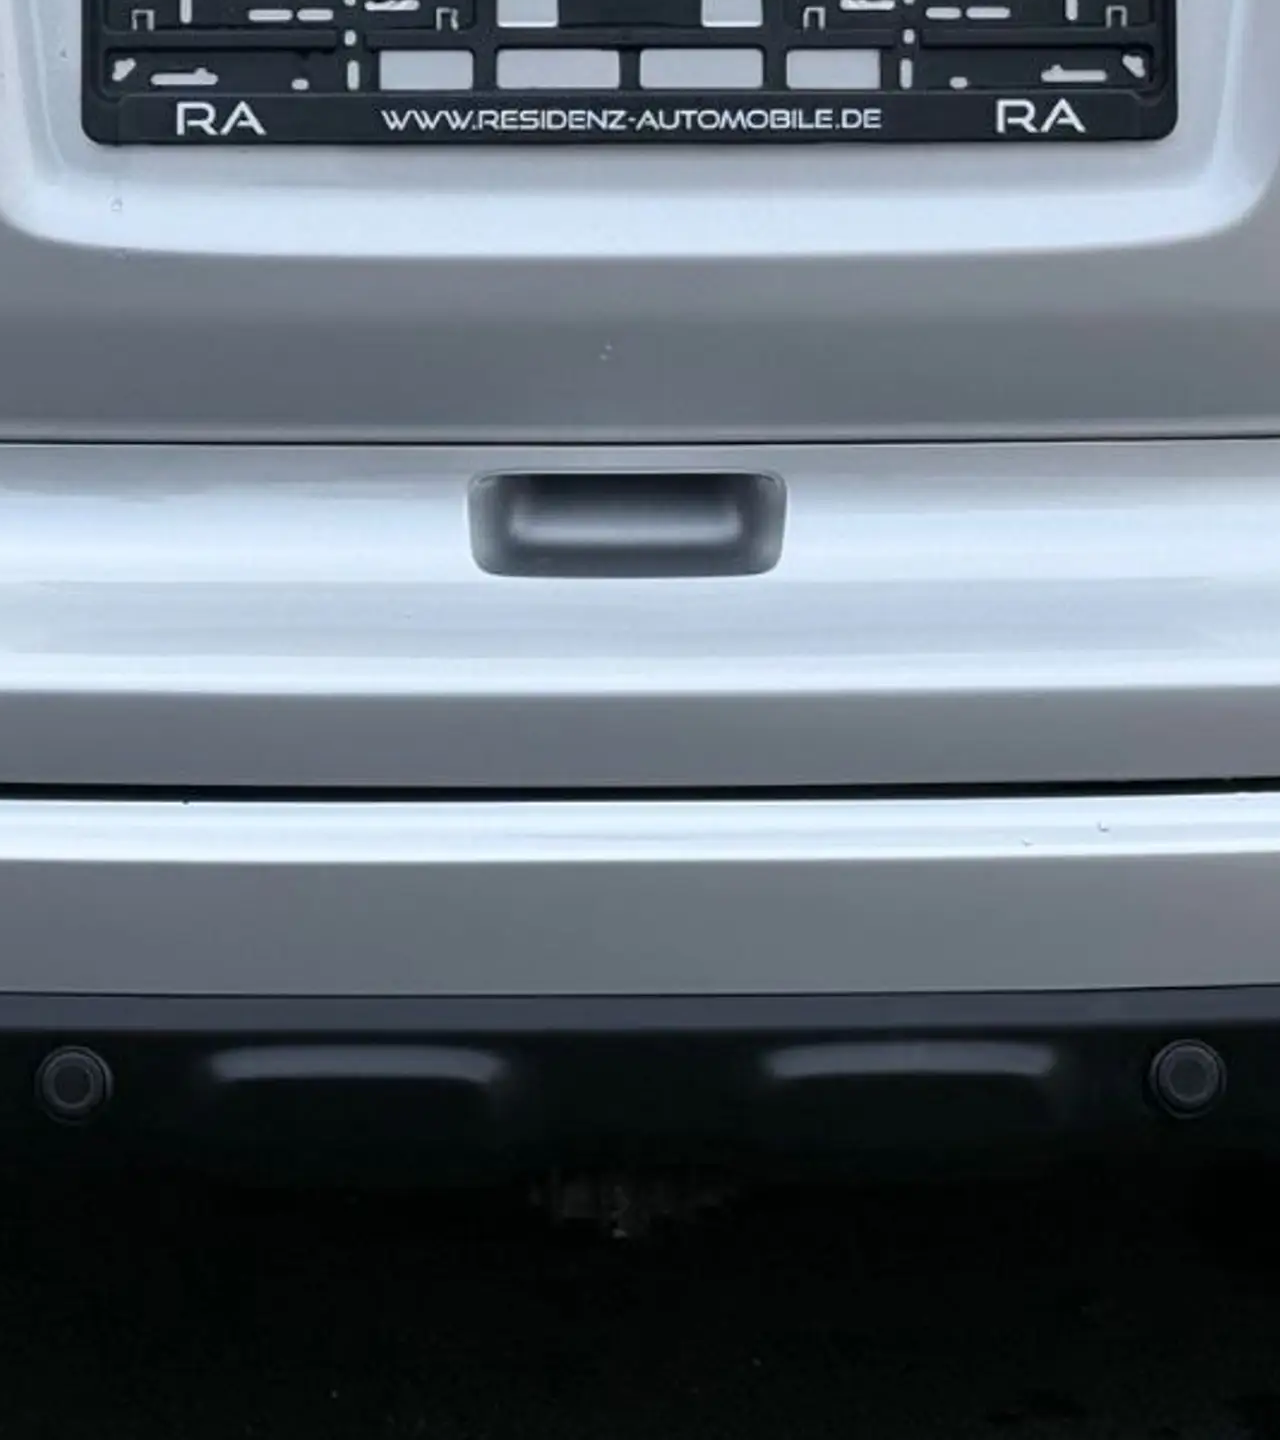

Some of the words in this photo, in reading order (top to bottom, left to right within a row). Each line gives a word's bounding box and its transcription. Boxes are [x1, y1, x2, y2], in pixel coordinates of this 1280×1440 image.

[175, 100, 268, 136] RA
[379, 108, 883, 132] WWW.RESIDENZ-AUTOMOBILE.DE
[995, 97, 1087, 134] RA
